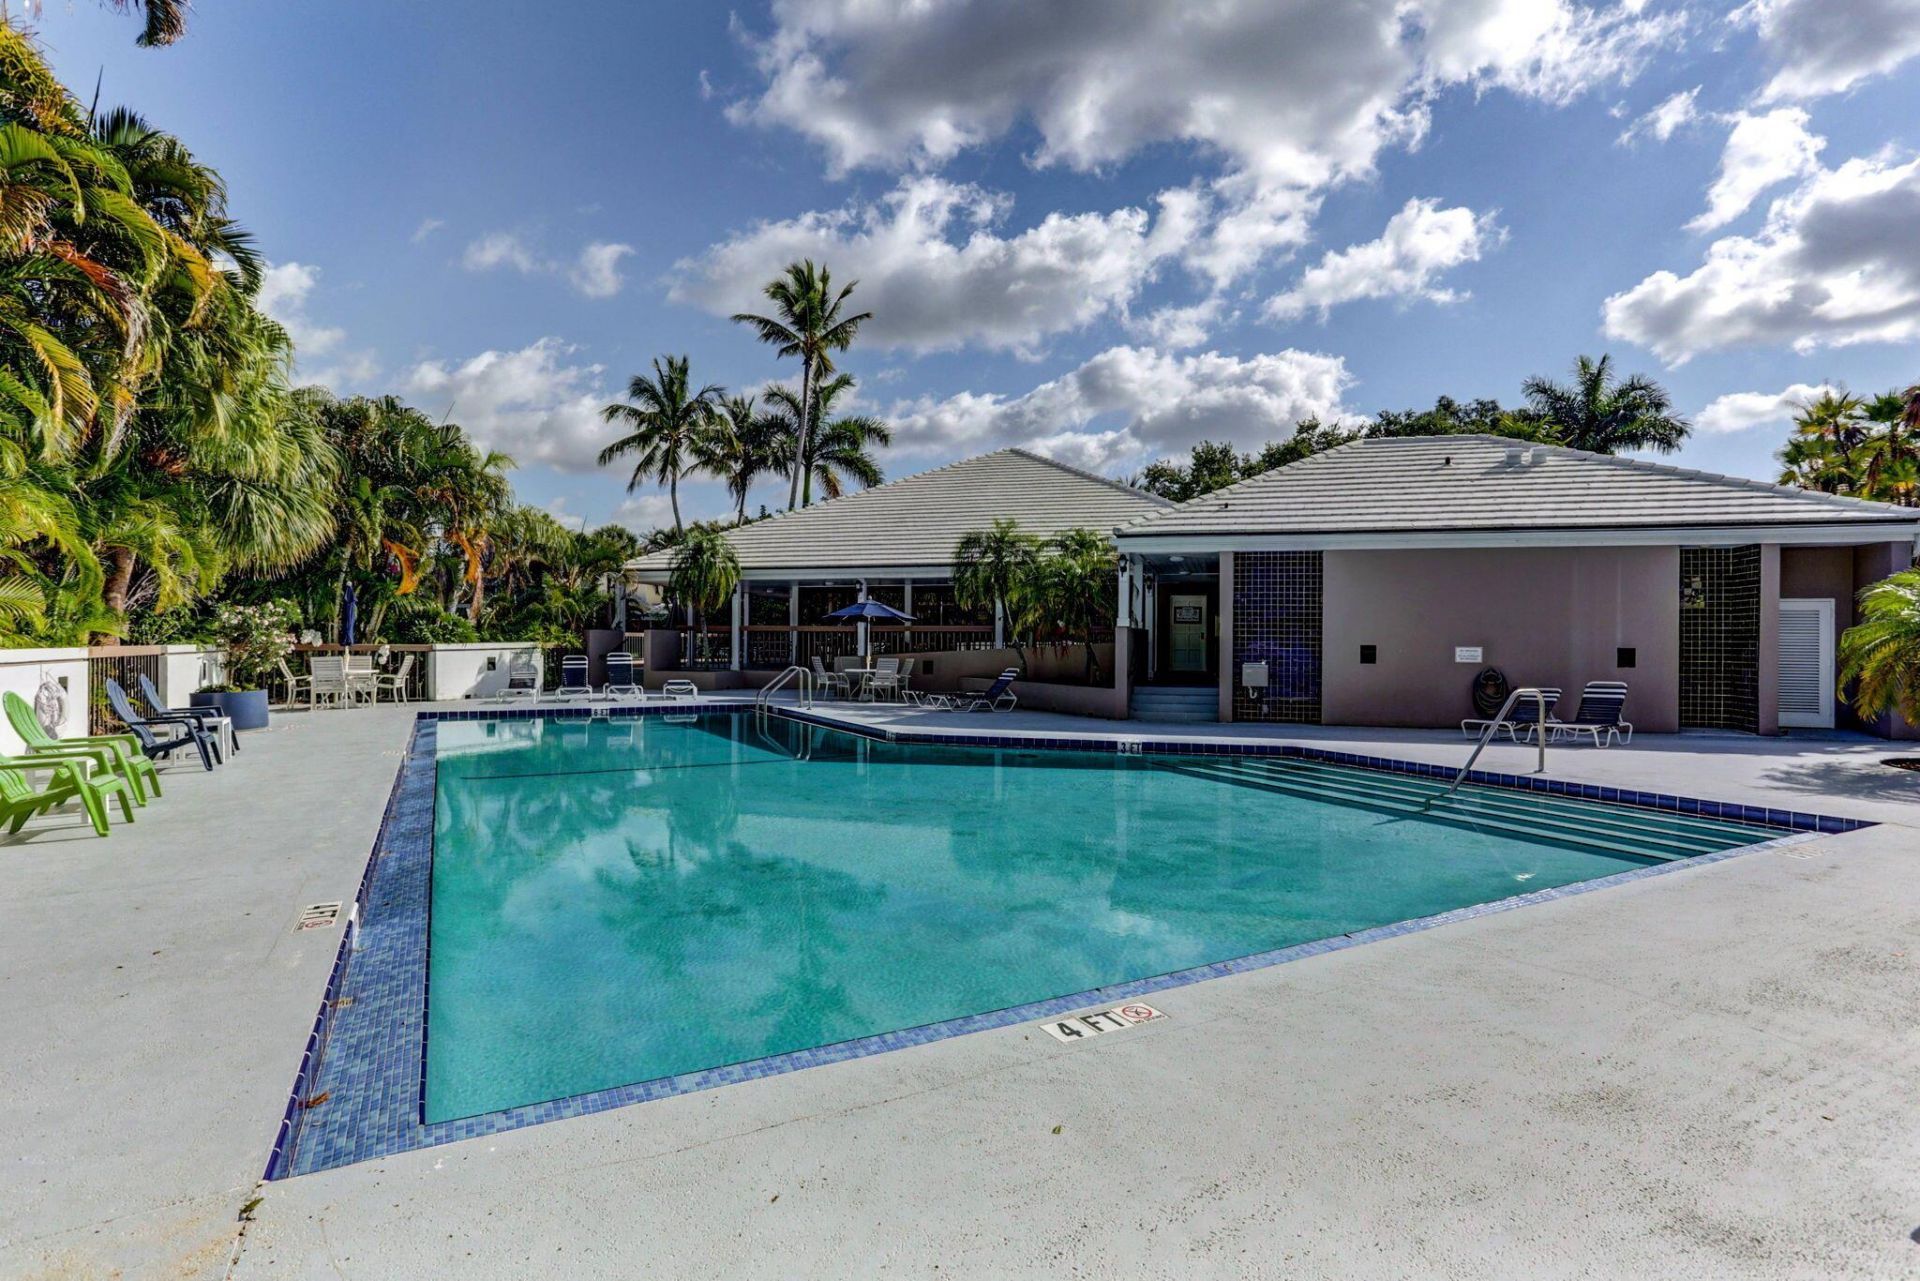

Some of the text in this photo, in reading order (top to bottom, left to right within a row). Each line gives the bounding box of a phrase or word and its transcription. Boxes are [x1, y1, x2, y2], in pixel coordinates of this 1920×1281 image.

[1121, 742, 1127, 754] 3
[1056, 1022, 1084, 1038] 4
[1080, 1011, 1125, 1032] FT
